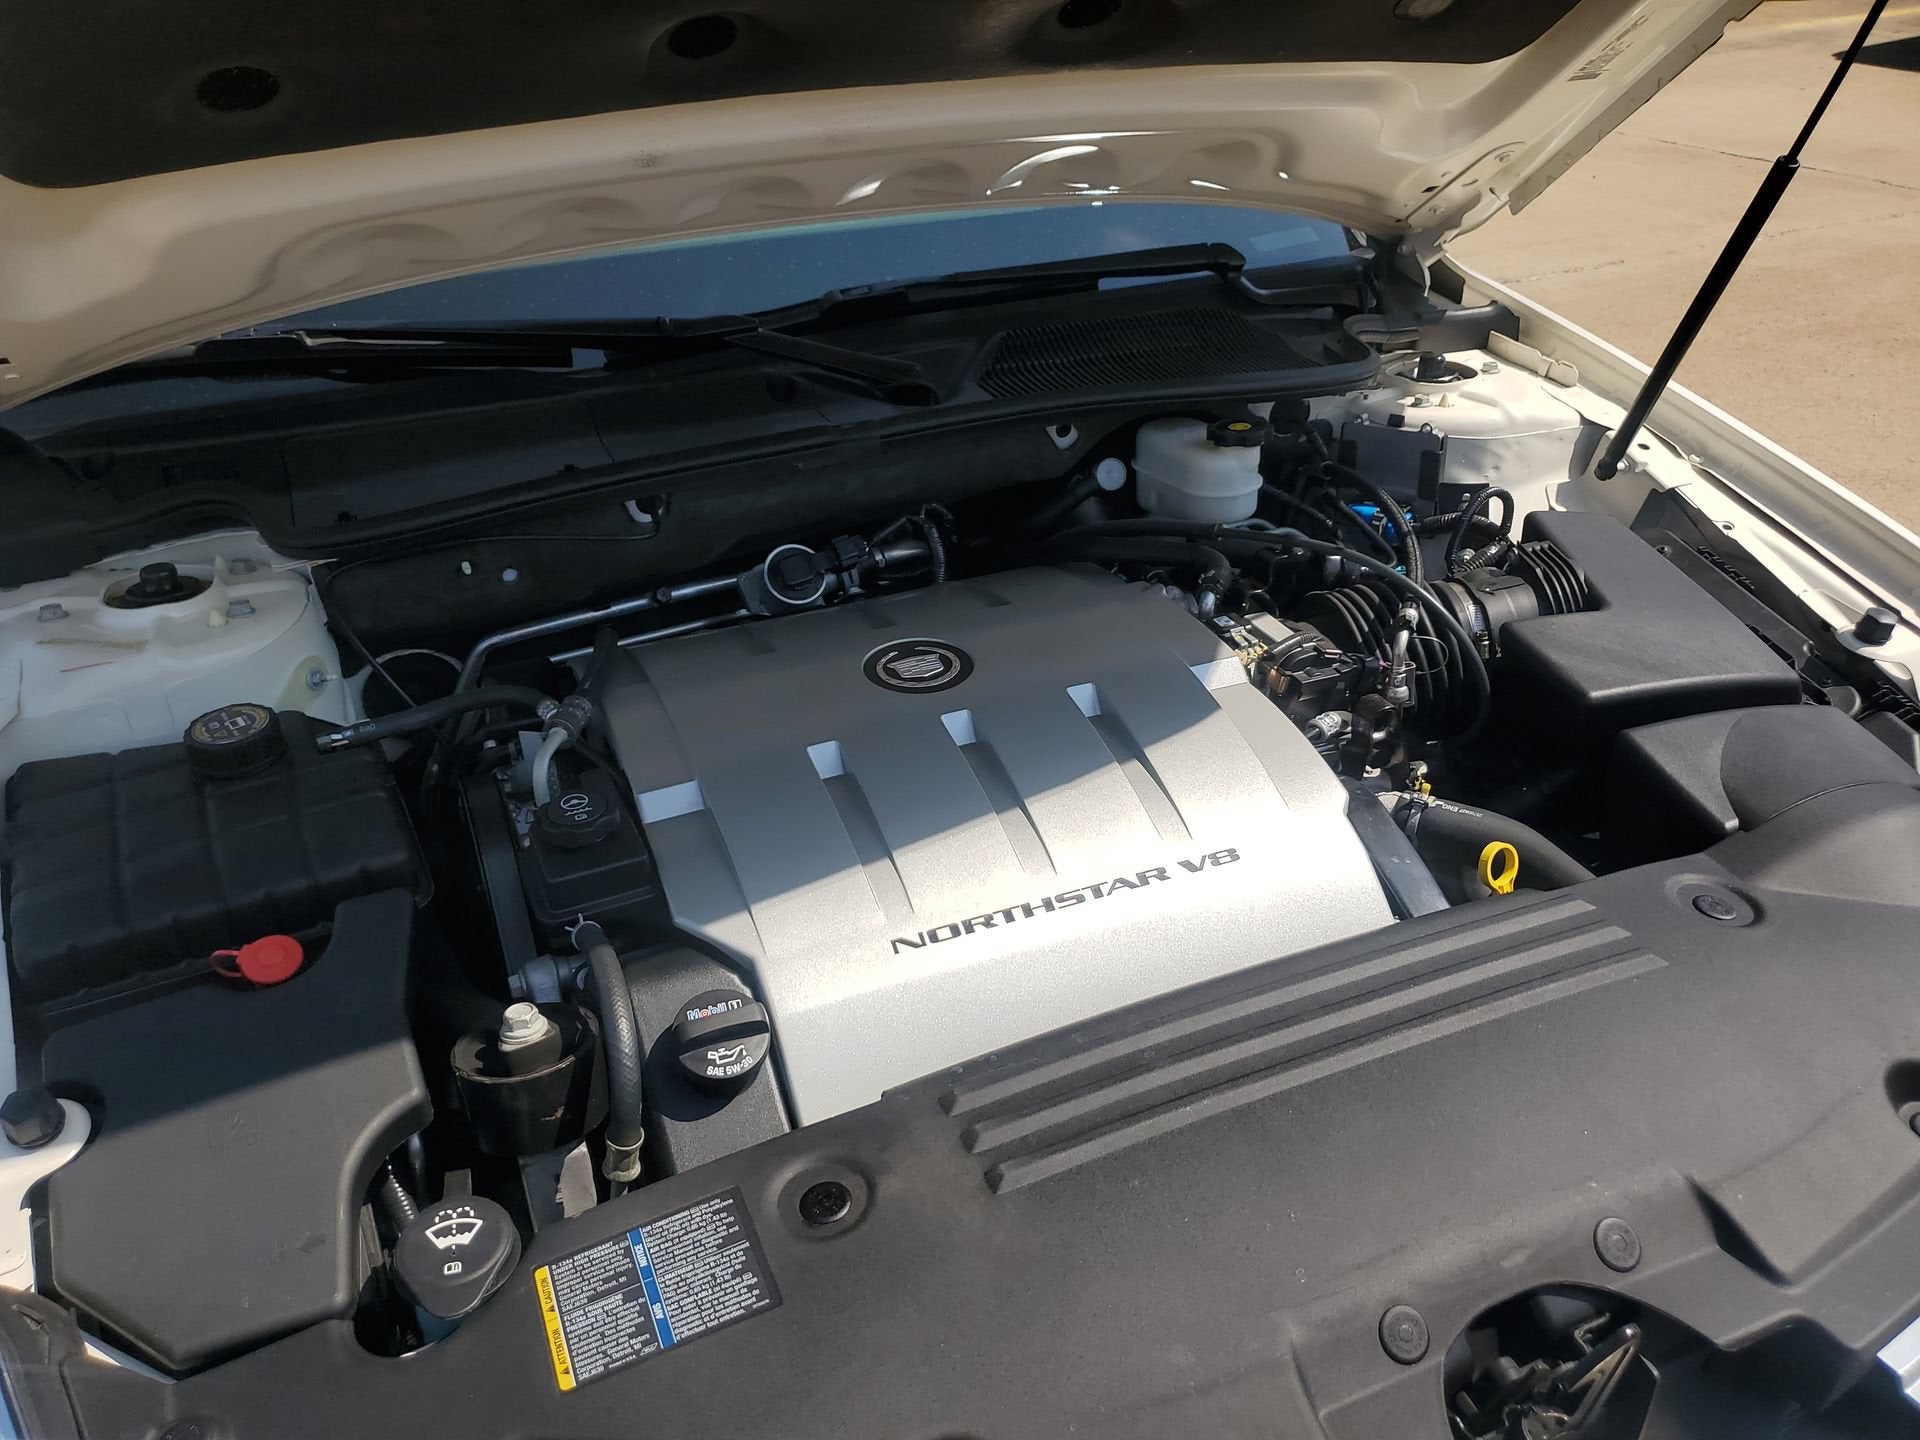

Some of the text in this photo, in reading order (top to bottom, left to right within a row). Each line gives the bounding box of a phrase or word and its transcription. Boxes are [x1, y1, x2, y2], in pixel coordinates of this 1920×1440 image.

[890, 848, 1240, 955] NORTHSTAR V8
[686, 1002, 728, 1020] Mobil
[706, 1056, 753, 1076] SAE 5W-30
[573, 1241, 613, 1260] REFRIGERANT
[633, 1242, 648, 1267] NOTICE
[660, 1240, 672, 1249] BAG
[552, 1244, 619, 1275] UNDER HIGH PRESSURE
[540, 1276, 552, 1304] CAUTION
[563, 1292, 623, 1320] FLUIDE FRIGORIGÈNE
[586, 1307, 603, 1317] SOUS
[603, 1298, 623, 1311] HAUTE
[651, 1301, 664, 1320] AVIS
[566, 1316, 596, 1332] PRESSION
[551, 1327, 567, 1366] ATTENTION
